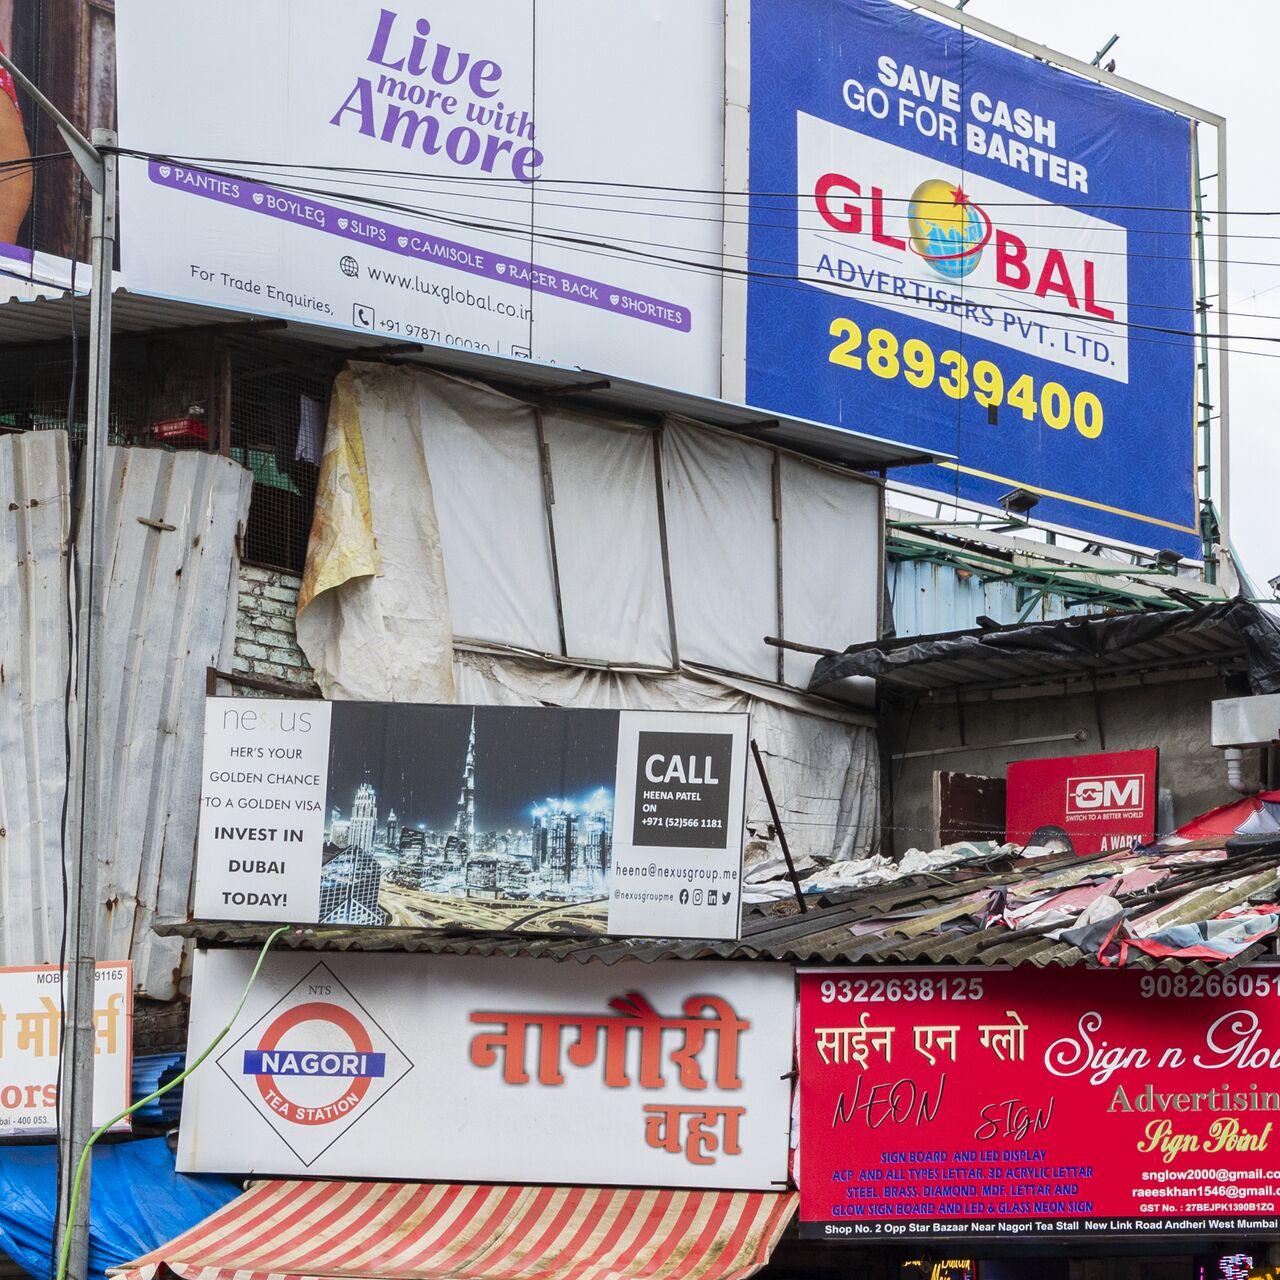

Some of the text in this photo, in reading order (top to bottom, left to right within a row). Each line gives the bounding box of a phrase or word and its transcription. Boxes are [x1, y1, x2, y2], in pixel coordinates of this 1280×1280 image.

[367, 8, 502, 98] Live
[377, 74, 536, 140] more with
[878, 56, 1055, 148] SAVE CASH
[329, 77, 544, 184] Amore
[842, 78, 1088, 194] GO FOR BARTER
[175, 169, 682, 324] PANTIES BOYLEG SLIPS CAMISOLE RACER BACK SHORTIES
[191, 265, 334, 315] For Trade Enquiries,
[368, 266, 534, 322] www.luxglobal.co.in
[816, 254, 1116, 366] ADVERTISERS PVT. LTD.
[380, 320, 441, 342] +91 97871
[828, 318, 1103, 439] 28939400
[224, 709, 312, 732] neus
[231, 747, 302, 760] HER'S YOUR
[210, 772, 320, 785] GOLDEN CHANCE
[645, 754, 718, 784] CALL
[205, 797, 321, 811] TO A GOLDEN VISA
[643, 791, 701, 801] HEENA PATEL
[1074, 779, 1140, 808] GM
[642, 804, 656, 812] ON
[1066, 814, 1087, 822] SWITCH
[215, 827, 304, 842] INVEST IN
[642, 817, 722, 828] +971 (52)566 1181
[229, 860, 285, 874] DUBAI
[616, 862, 737, 883] heena@nexusgroup.me
[222, 892, 287, 906] TODAY!
[309, 985, 332, 995] NTS
[821, 977, 983, 1003] 9322638125
[814, 1011, 1028, 1070] साईन एन ग्लो
[1044, 1011, 1151, 1085] Sign
[1158, 1047, 1186, 1068] n
[261, 1053, 367, 1074] NAGORI
[264, 1089, 359, 1120] TEA STATION
[832, 1073, 946, 1129] NEON
[18, 1116, 31, 1124] 400
[644, 1104, 745, 1164] चहा
[1137, 1117, 1273, 1163] Sign Point
[1140, 1204, 1158, 1213] GST
[825, 1225, 852, 1235] Shop
[855, 1224, 872, 1233] No.
[875, 1224, 881, 1233] 2
[884, 1224, 906, 1235] Opp
[909, 1223, 930, 1232] Star
[933, 1223, 969, 1232] Bazaar
[971, 1222, 996, 1231] Near
[998, 1221, 1032, 1233] Nagori
[1035, 1222, 1053, 1231] Tea
[1056, 1221, 1079, 1230] Stall
[1085, 1221, 1107, 1230] New
[1110, 1220, 1132, 1230] Link
[1136, 1220, 1162, 1229] Road
[1164, 1219, 1206, 1229] Andheri
[1208, 1219, 1235, 1229] West
[1238, 1219, 1278, 1229] Mumbai
